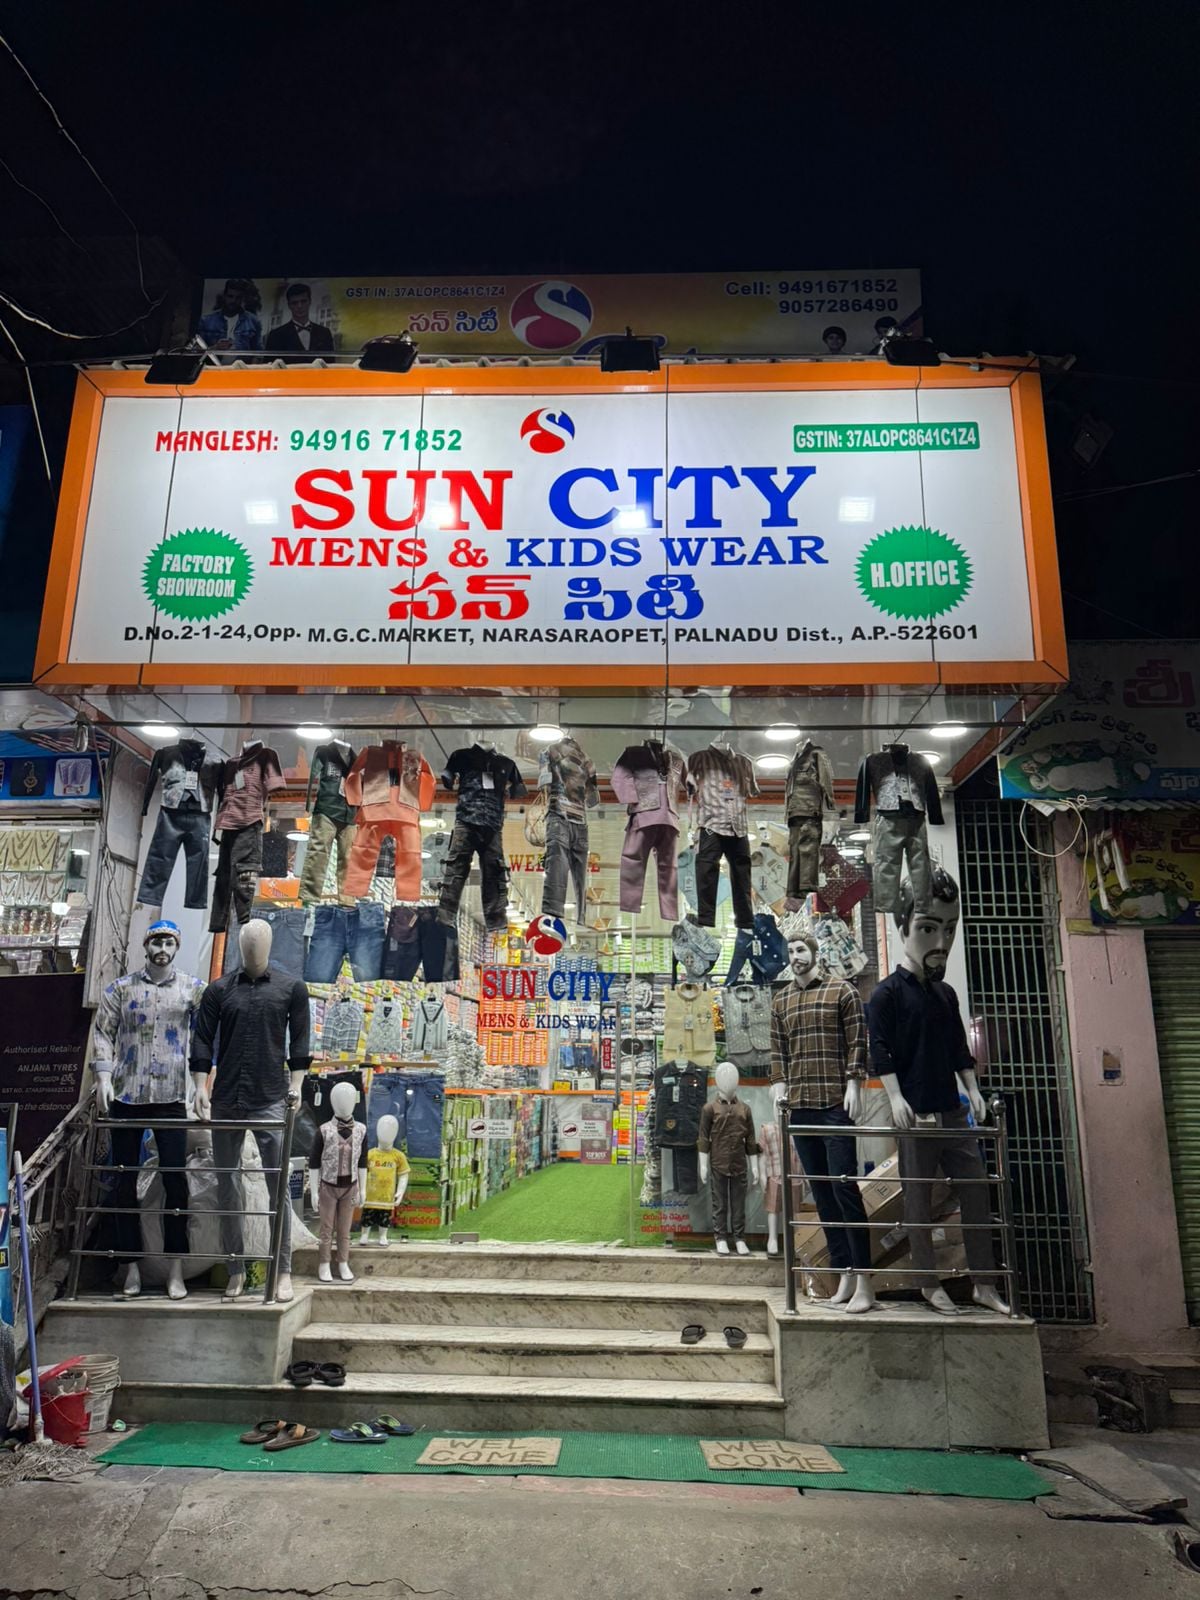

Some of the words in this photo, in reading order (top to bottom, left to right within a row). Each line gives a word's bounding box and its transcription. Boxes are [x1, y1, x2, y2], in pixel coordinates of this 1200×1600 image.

[346, 288, 371, 298] GST
[374, 288, 391, 297] IN:
[394, 286, 506, 297] 37ALOPC8641C1Z4
[726, 282, 770, 295] Cell:
[778, 279, 897, 294] 9491671852
[779, 299, 898, 313] 9057286490
[409, 310, 449, 333] సన్
[456, 307, 498, 333] సిటీ
[156, 430, 278, 453] MANGLESH:
[290, 429, 370, 452] 94916
[382, 429, 462, 452] 71852
[796, 430, 843, 449] GSTIN:
[846, 428, 976, 448] 37ALOPC8641C1Z4
[291, 468, 512, 531] SUN
[549, 466, 816, 530] CITY
[269, 537, 427, 567] MENS
[448, 538, 489, 567] &
[505, 537, 643, 567] KIDS
[660, 536, 829, 567] WEAR
[161, 554, 235, 574] FACTORY
[870, 560, 960, 588] H.OFFICE
[157, 578, 236, 598] SHOWROOM
[388, 571, 531, 620] సన్
[308, 628, 475, 645] M.G.C.MARKET,
[483, 628, 667, 645] NARASARAOPET,
[675, 628, 778, 642] PALNADU
[787, 627, 843, 643] Dist.,
[851, 625, 978, 641] A.P.-522601
[509, 854, 601, 873] WELE
[483, 970, 538, 1000] SUN
[548, 970, 616, 1001] CITY
[477, 1013, 516, 1028] MENS
[520, 1014, 530, 1028] &
[536, 1015, 575, 1029] KIDS
[4, 1045, 48, 1054] Authorised
[49, 1044, 81, 1053] Retailer
[17, 1064, 50, 1072] ANJANA
[53, 1063, 78, 1072] TYRES
[450, 1439, 528, 1449] WEL
[716, 1440, 802, 1455] WEL
[429, 1450, 547, 1463] COME
[714, 1454, 833, 1470] COME
